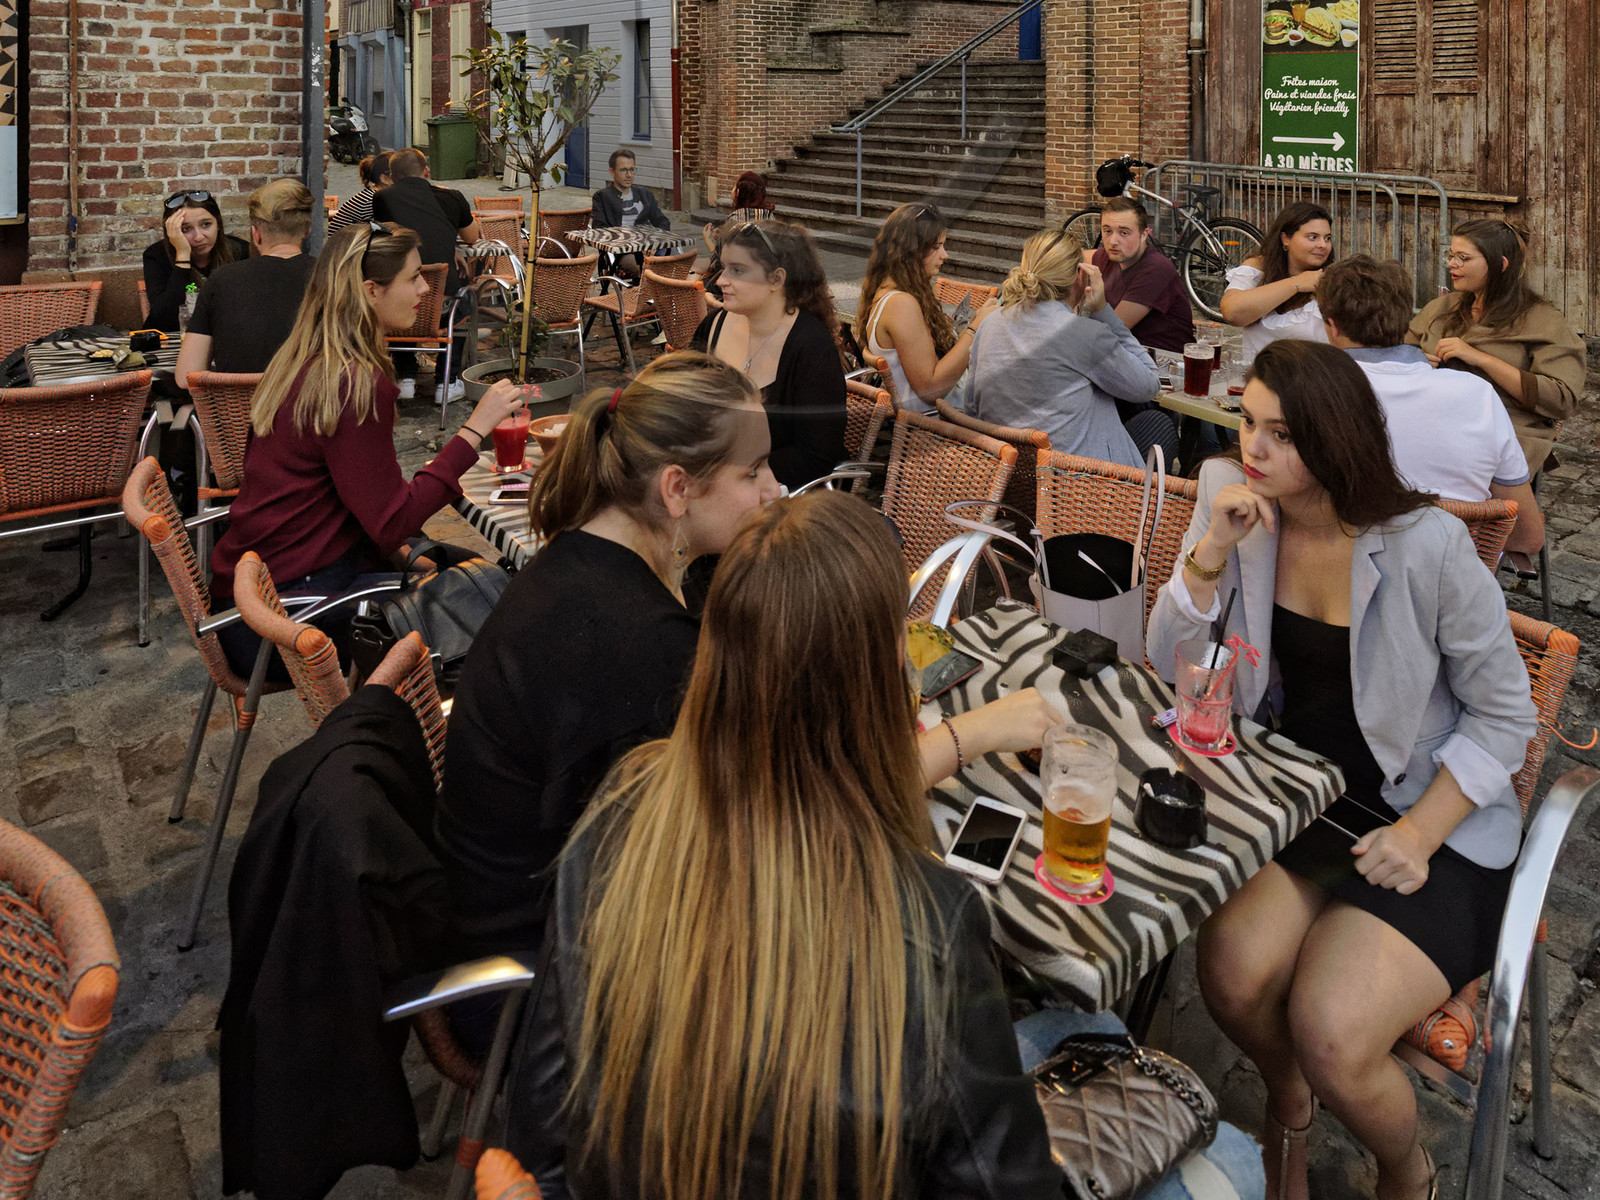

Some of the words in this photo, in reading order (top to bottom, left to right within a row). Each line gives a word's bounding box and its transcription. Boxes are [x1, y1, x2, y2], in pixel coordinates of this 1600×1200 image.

[1308, 77, 1339, 86] maison
[1264, 88, 1289, 100] Pains
[1290, 88, 1299, 99] et
[1299, 88, 1332, 99] viandes
[1333, 88, 1356, 102] frais
[1269, 101, 1313, 116] Végétarien
[1313, 101, 1349, 117] friendly
[1264, 153, 1273, 168] A
[1277, 154, 1294, 169] 30
[1298, 151, 1354, 173] MÈTRES
